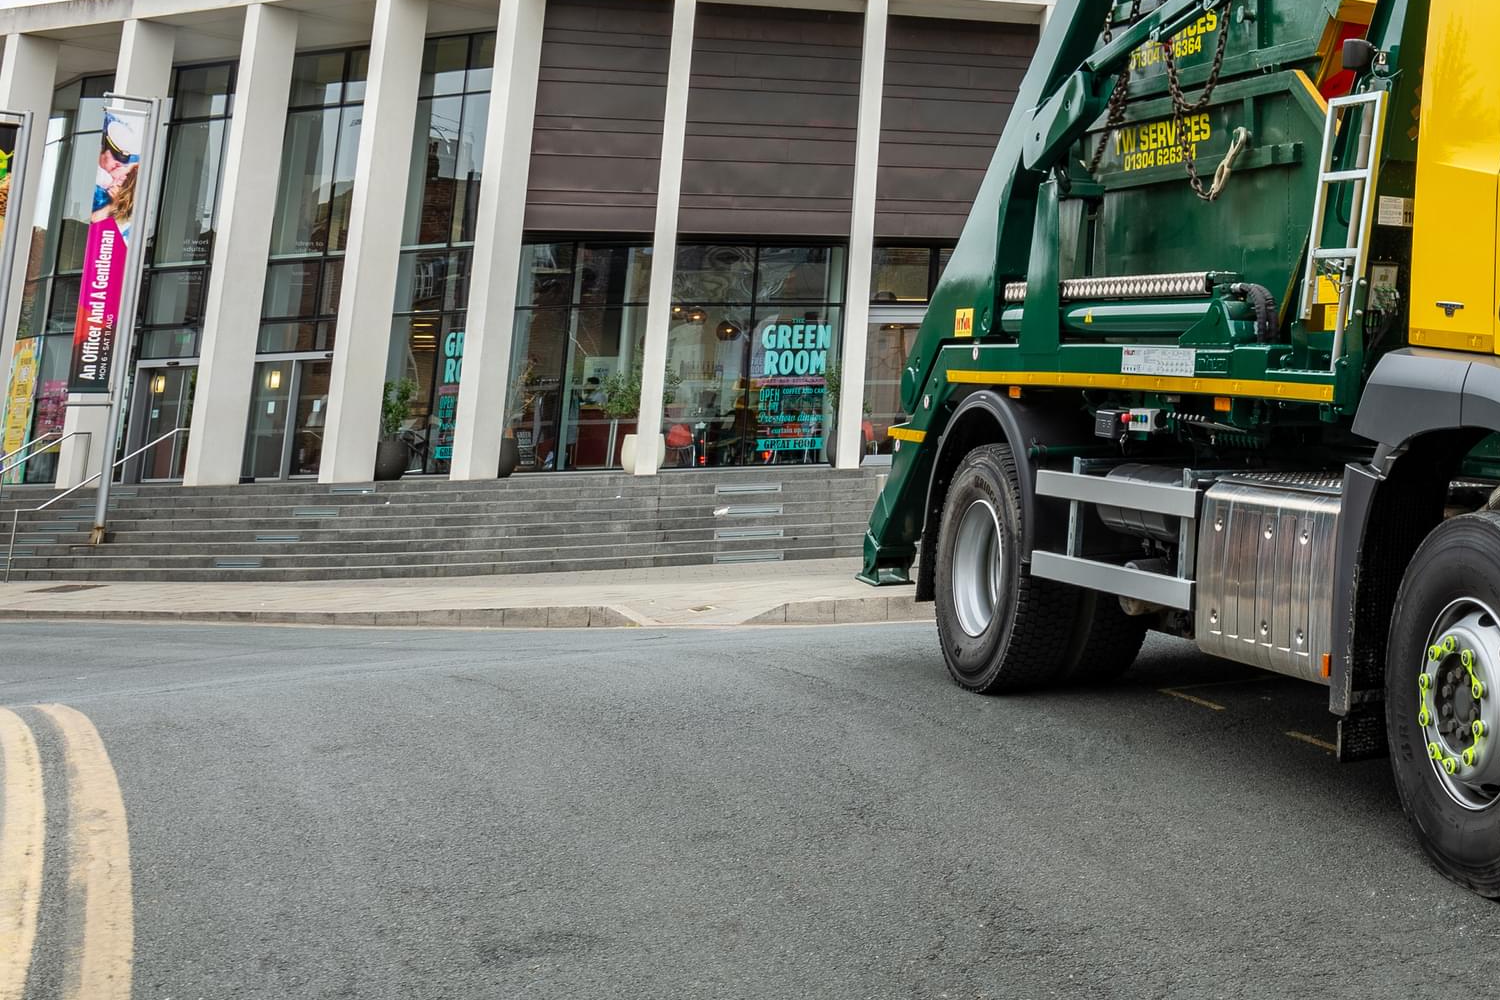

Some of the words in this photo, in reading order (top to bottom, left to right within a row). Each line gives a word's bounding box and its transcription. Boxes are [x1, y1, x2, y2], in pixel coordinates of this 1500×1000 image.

[1124, 150, 1155, 172] 01304
[1156, 142, 1197, 166] 62634
[92, 230, 116, 288] Gentleman
[90, 290, 107, 300] A
[87, 301, 106, 323] And
[106, 314, 114, 329] AUG
[81, 326, 102, 362] Officer
[103, 336, 112, 351] SAT
[762, 324, 832, 350] GREEN
[79, 364, 97, 380] An
[99, 362, 108, 380] MON
[764, 350, 827, 376] ROOM
[759, 388, 780, 402] OPEN
[764, 439, 790, 449] GREAT
[793, 438, 816, 449] FOOD
